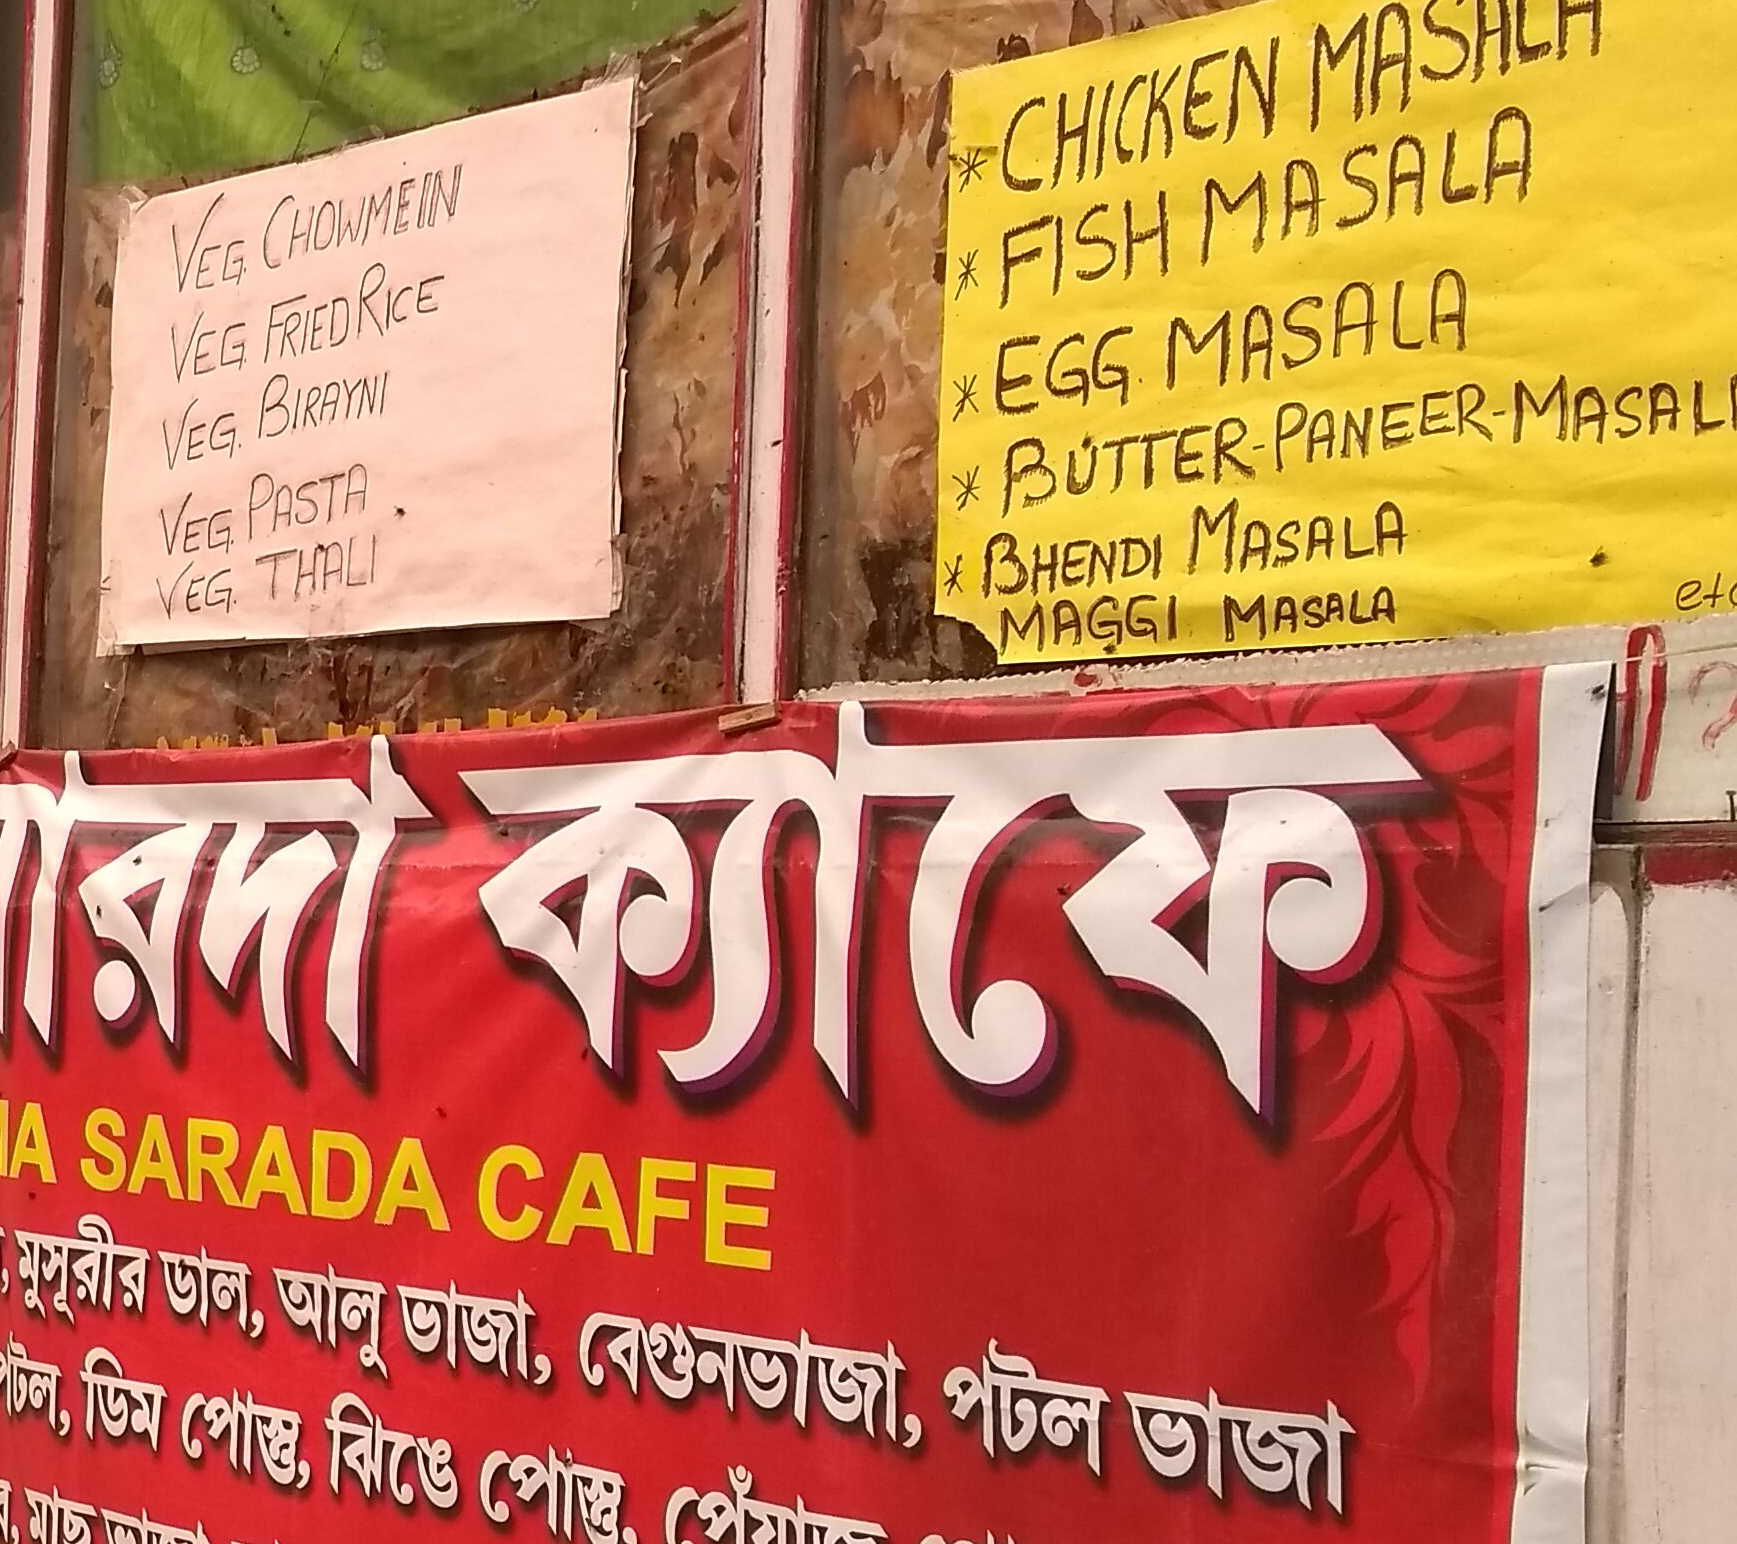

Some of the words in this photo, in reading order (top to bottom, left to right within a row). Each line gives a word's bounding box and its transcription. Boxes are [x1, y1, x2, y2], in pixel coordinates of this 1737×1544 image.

[1001, 37, 1280, 195] CHICKEN
[263, 164, 462, 269] CHOWMEIN
[999, 192, 1169, 309] FISH
[1201, 106, 1534, 266] MASALA
[264, 294, 349, 364] FRIED
[357, 262, 445, 337] RICE
[1167, 268, 1467, 391] MASALA
[248, 464, 368, 541] PASTA
[982, 533, 1162, 598] BHENDI
[1188, 498, 1407, 578] MASALA
[255, 534, 377, 602] THALI
[999, 594, 1175, 656] MAGGI
[1223, 586, 1396, 643] MASALA
[457, 699, 1422, 1115] ক্যাফে
[82, 1110, 449, 1231] SARADA
[476, 1144, 776, 1270] CAFE
[80, 1346, 166, 1453] ডিম
[325, 1391, 458, 1509] ঝিঙে
[158, 1246, 264, 1338] ডাল,
[273, 1263, 387, 1378] আলু
[398, 1279, 552, 1385] ভাজা,
[579, 1311, 922, 1448] বেগুনভাজা,
[943, 1337, 1110, 1476] পটল
[1124, 1387, 1357, 1516] ভাজা
